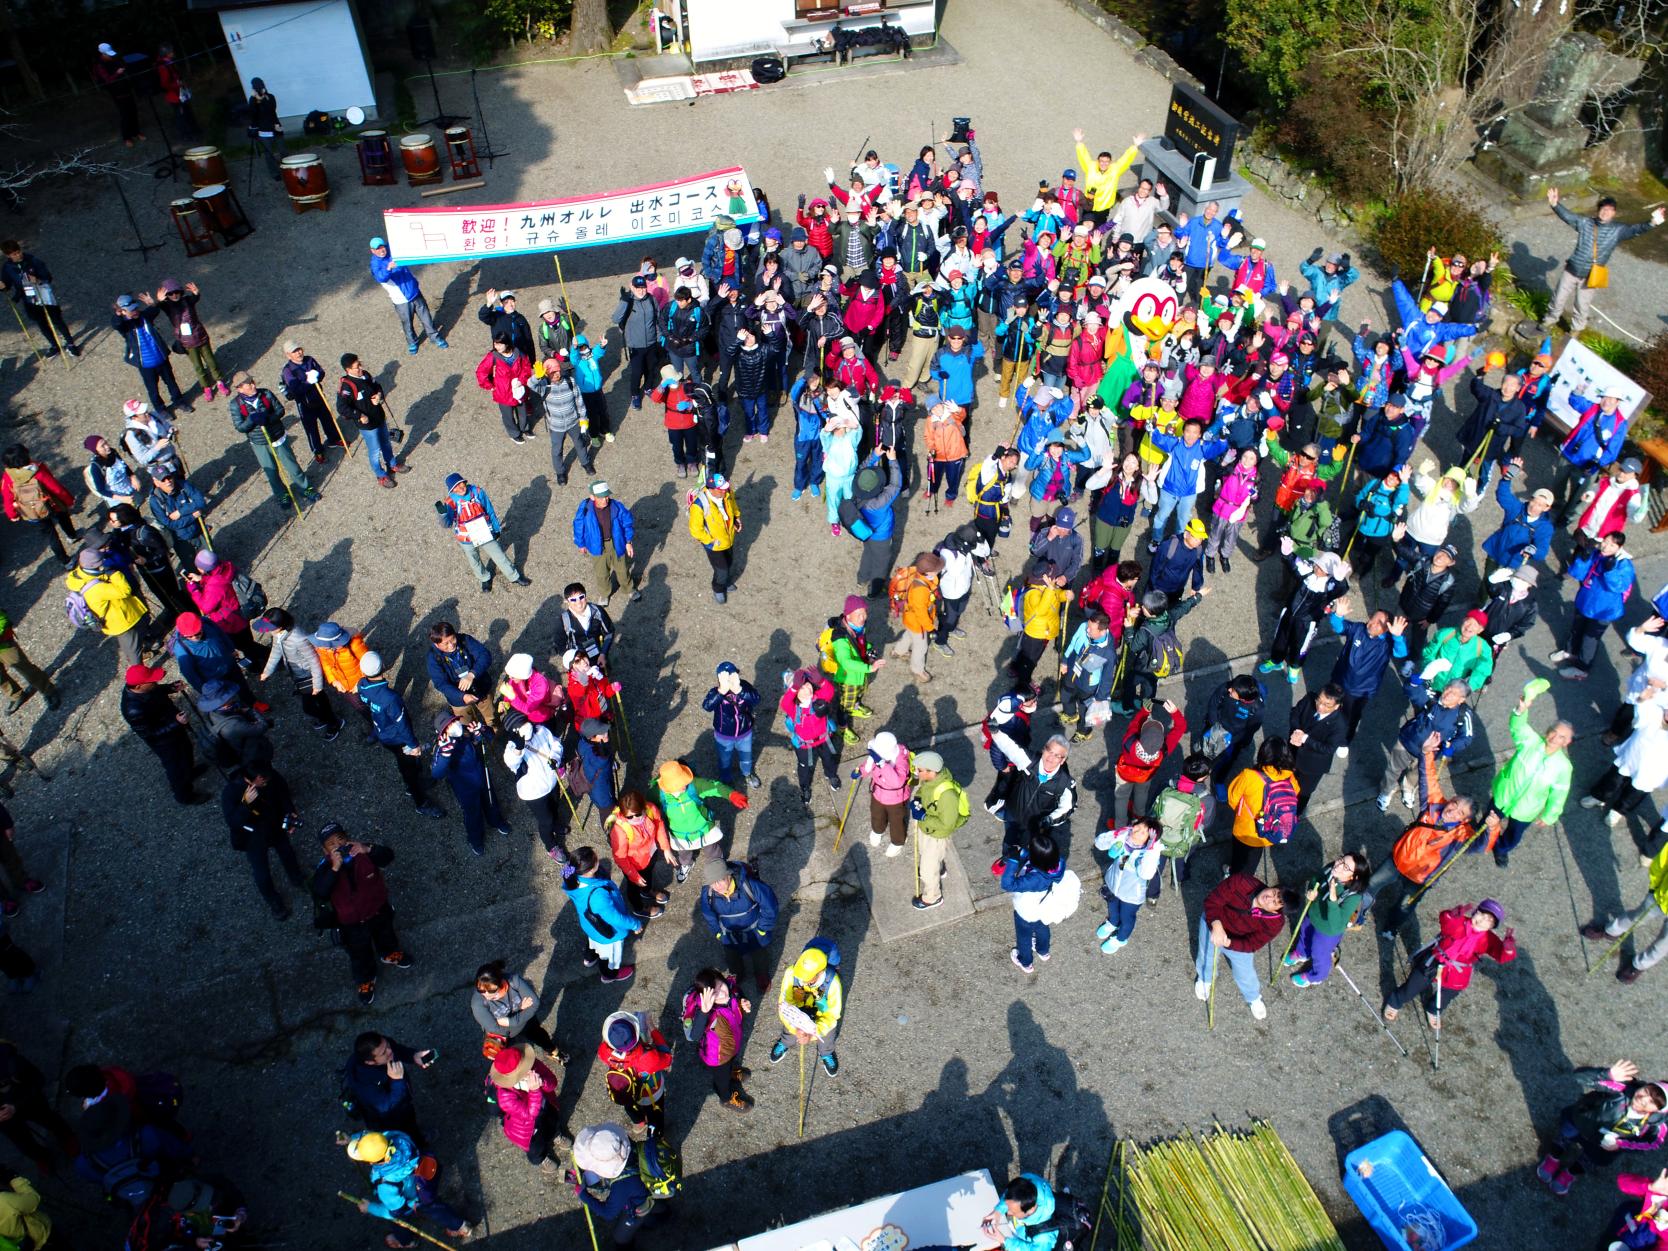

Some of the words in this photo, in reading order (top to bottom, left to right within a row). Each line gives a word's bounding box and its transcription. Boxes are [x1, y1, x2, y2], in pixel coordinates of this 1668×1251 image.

[462, 217, 508, 234] 歓迎！
[520, 206, 612, 229] 九州オルレ
[630, 186, 718, 214] 出水コース
[464, 236, 508, 251] 환영!
[526, 230, 560, 245] 규슈
[575, 222, 608, 240] 올레
[631, 210, 681, 231] 이즈미
